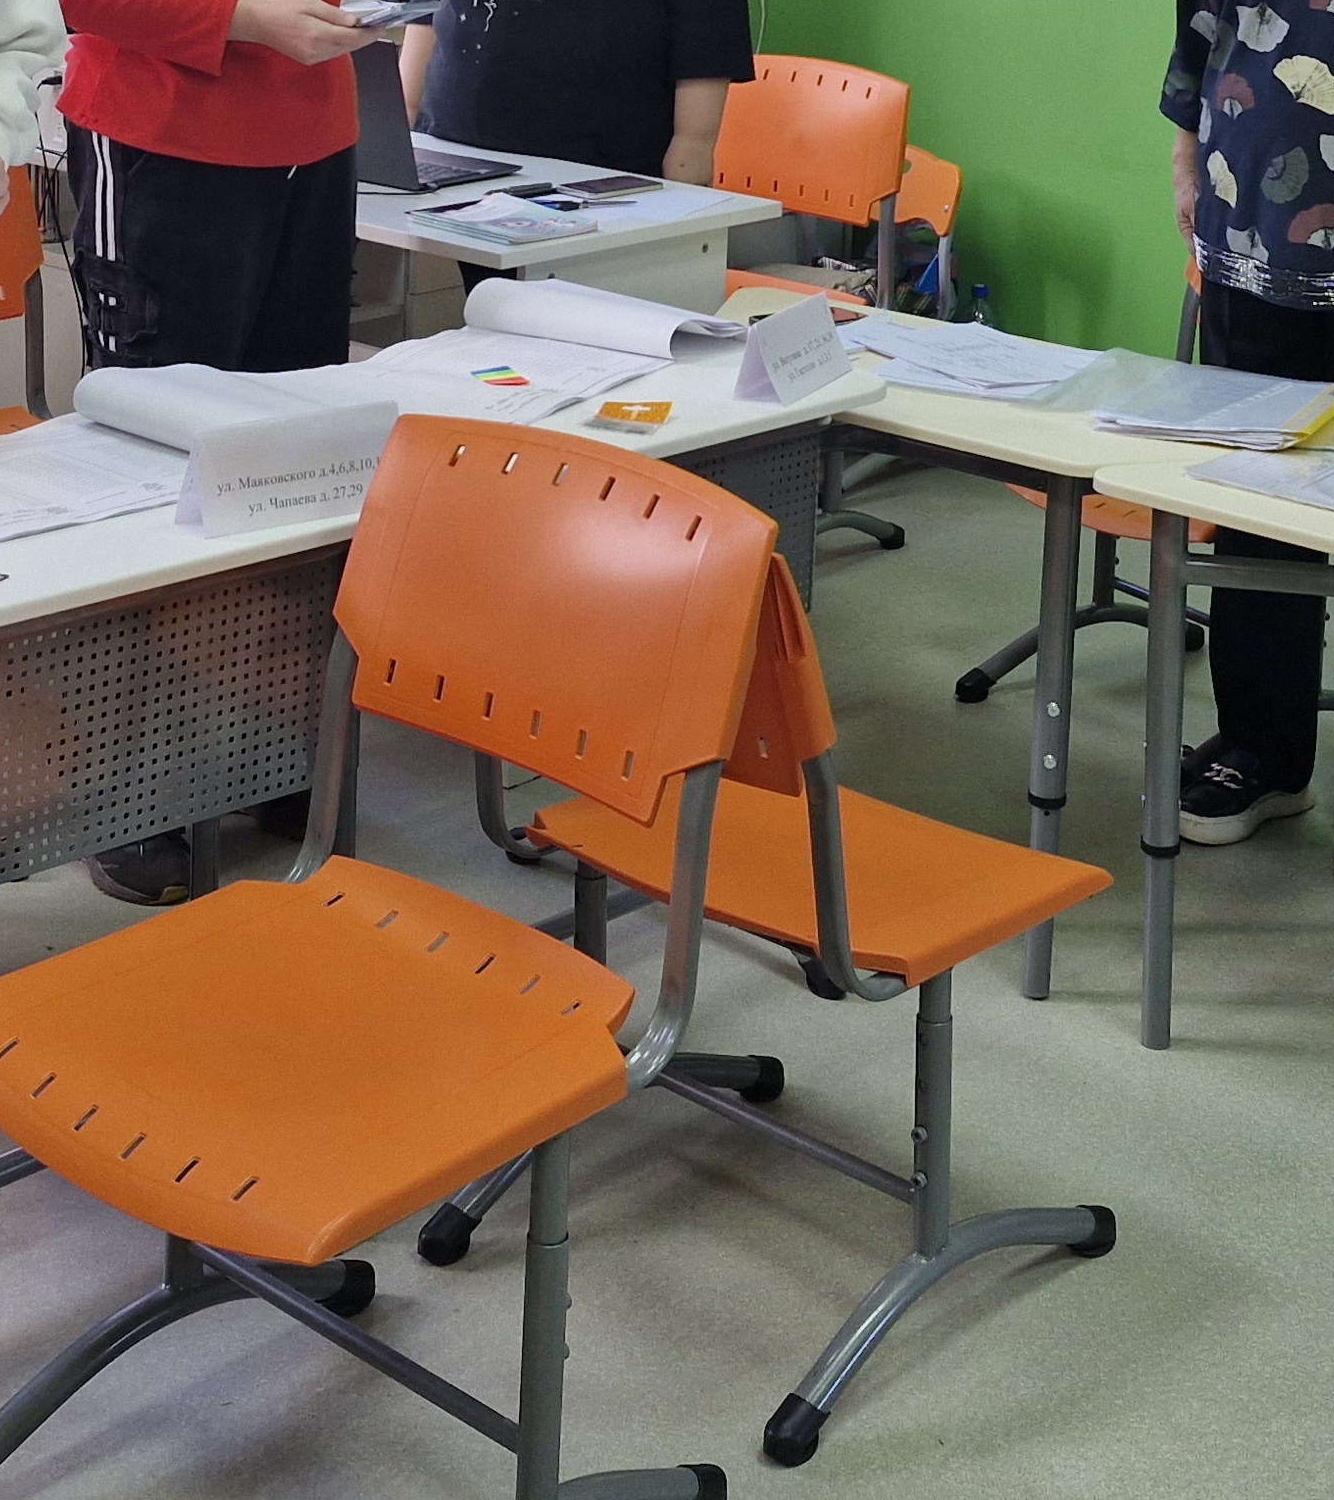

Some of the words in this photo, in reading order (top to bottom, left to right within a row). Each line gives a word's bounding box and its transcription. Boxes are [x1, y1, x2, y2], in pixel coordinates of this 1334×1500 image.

[217, 483, 235, 496] ул.
[238, 470, 316, 490] Маяковского
[248, 503, 266, 516] ул.
[269, 495, 317, 509] Чапаева
[319, 492, 331, 503] д.
[332, 483, 363, 501] 27,29
